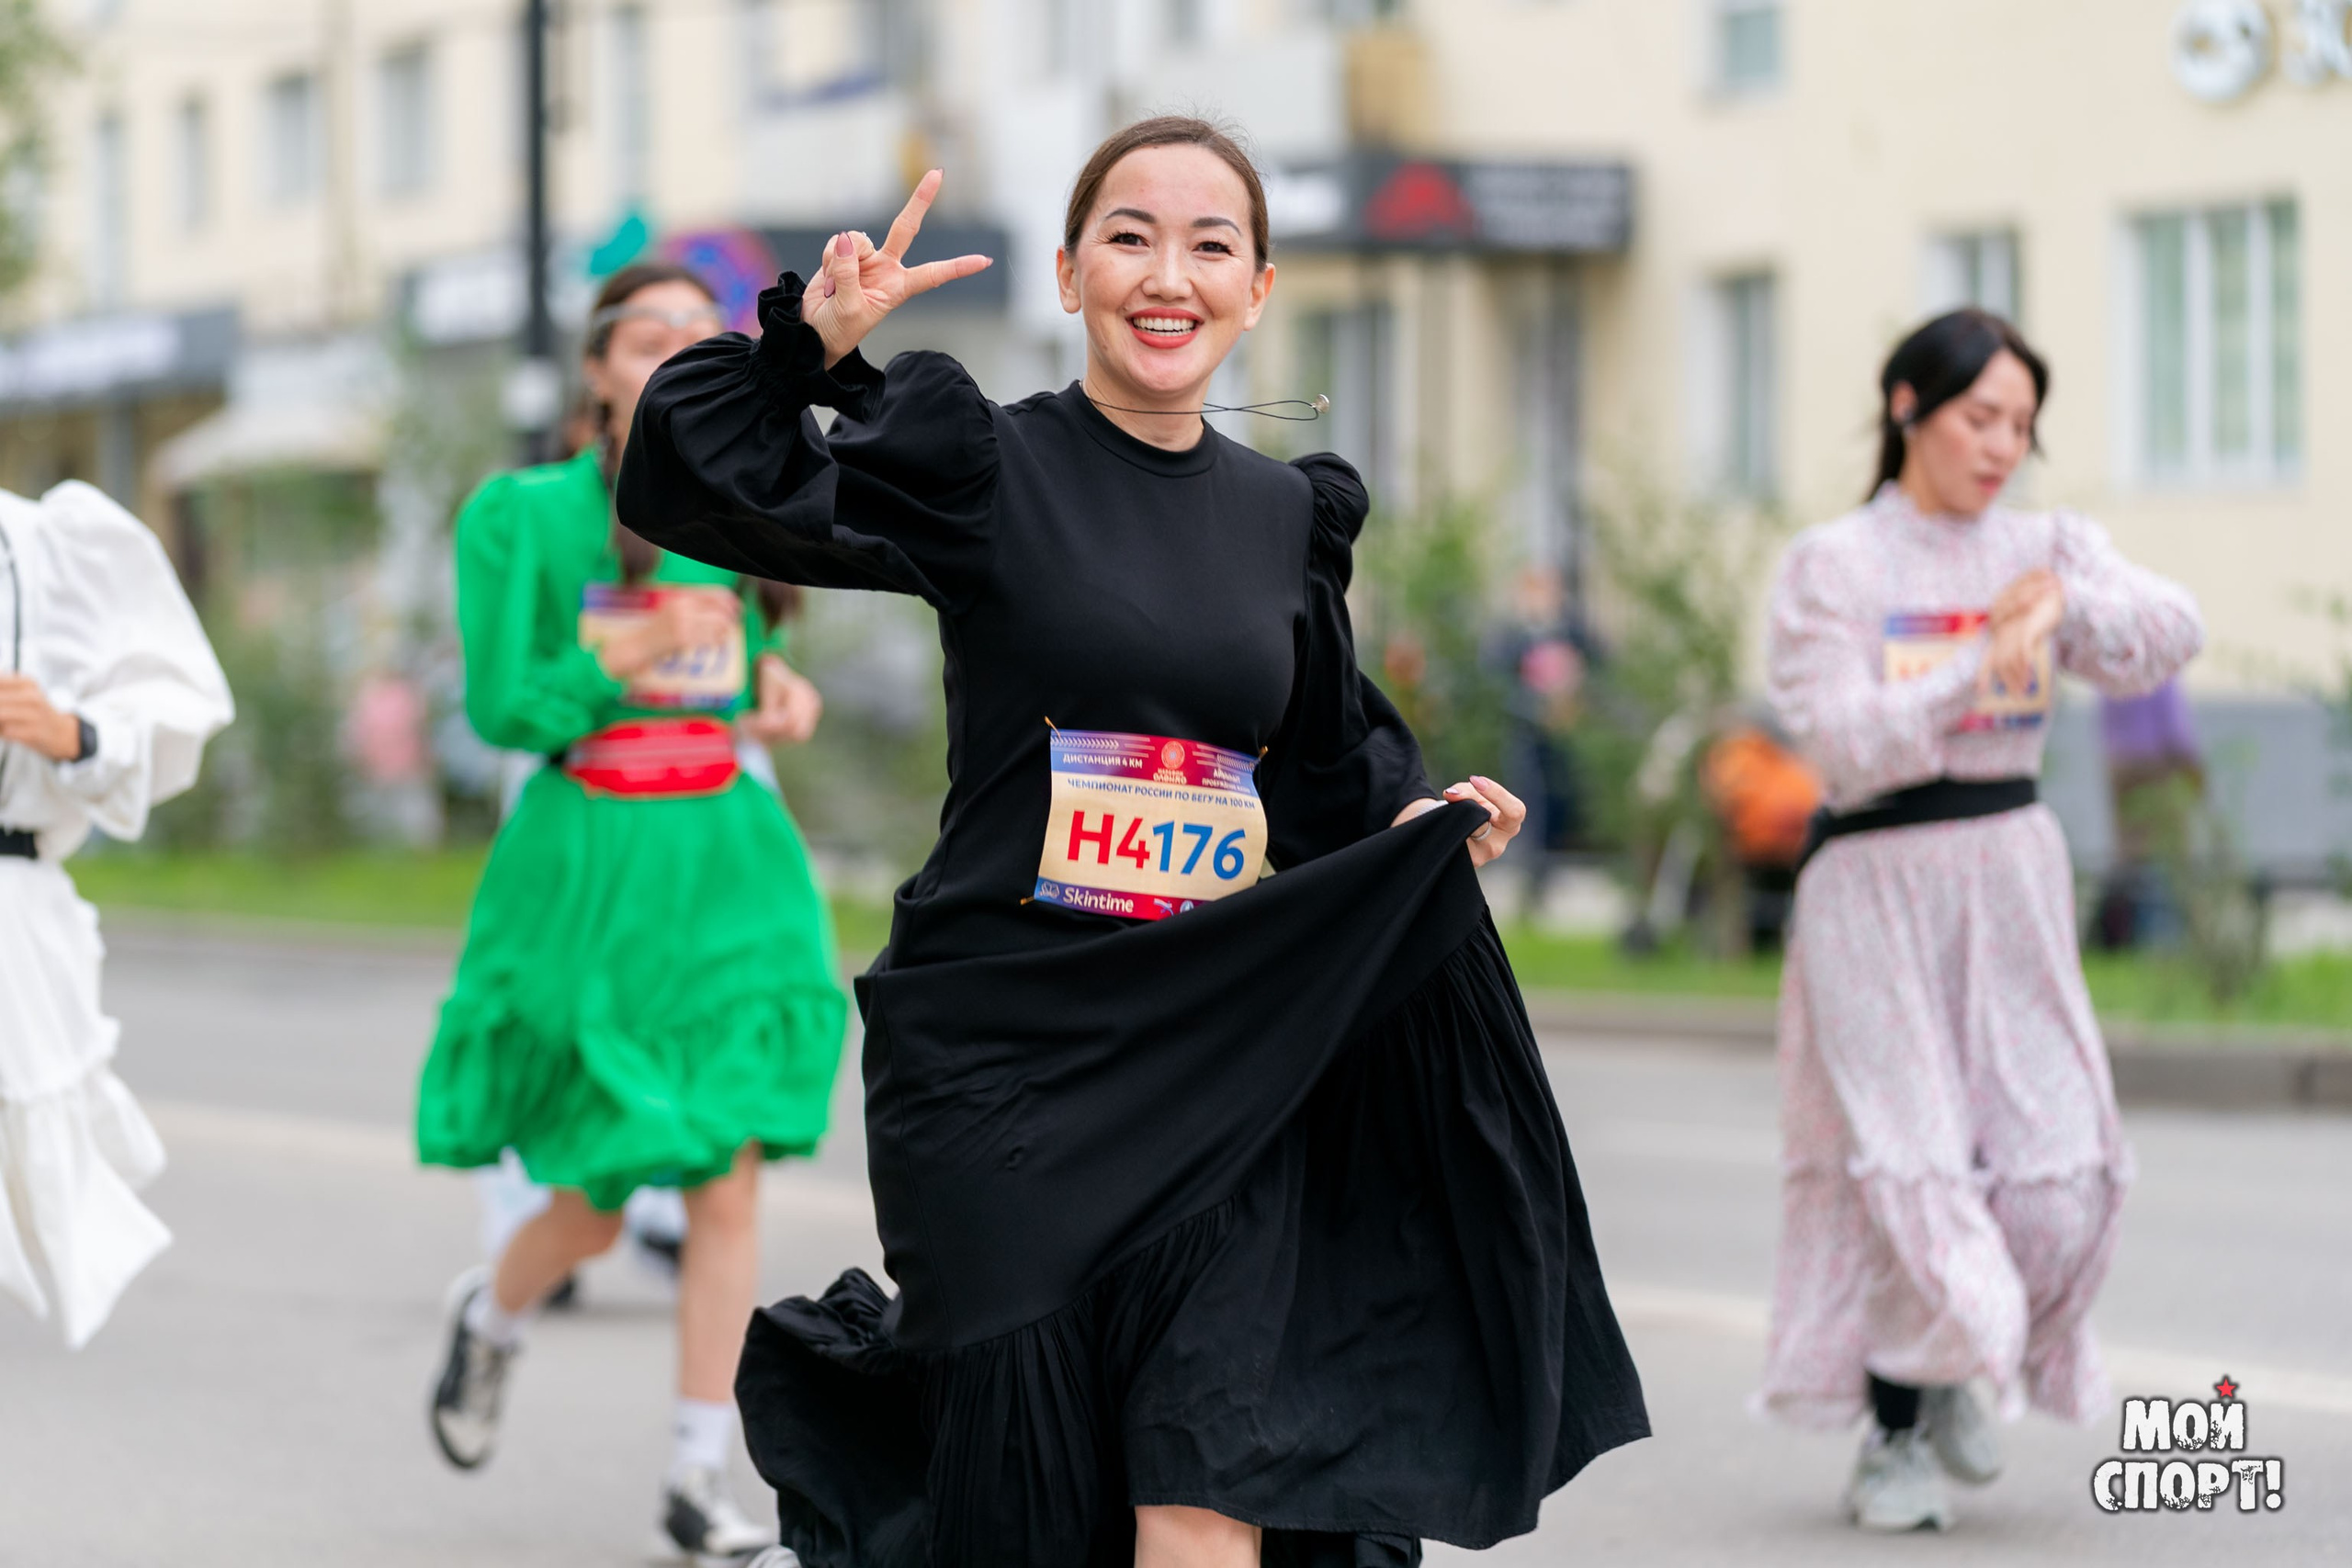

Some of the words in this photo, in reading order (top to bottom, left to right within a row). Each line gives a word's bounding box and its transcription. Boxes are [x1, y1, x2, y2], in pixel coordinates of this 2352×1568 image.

[1063, 752, 1121, 766] ДИСТАНЦИЯ
[1122, 757, 1128, 767] 4
[1129, 758, 1143, 769] КМ
[1068, 778, 1133, 795] ЧЕМПИОНАТ
[1135, 787, 1173, 799] РОССИИ
[1174, 791, 1189, 801] ПО
[1191, 793, 1214, 806] БЕГУ
[1215, 796, 1227, 807] НА
[1229, 797, 1243, 808] 100
[1244, 799, 1256, 810] КМ
[1063, 886, 1135, 913] Skintime
